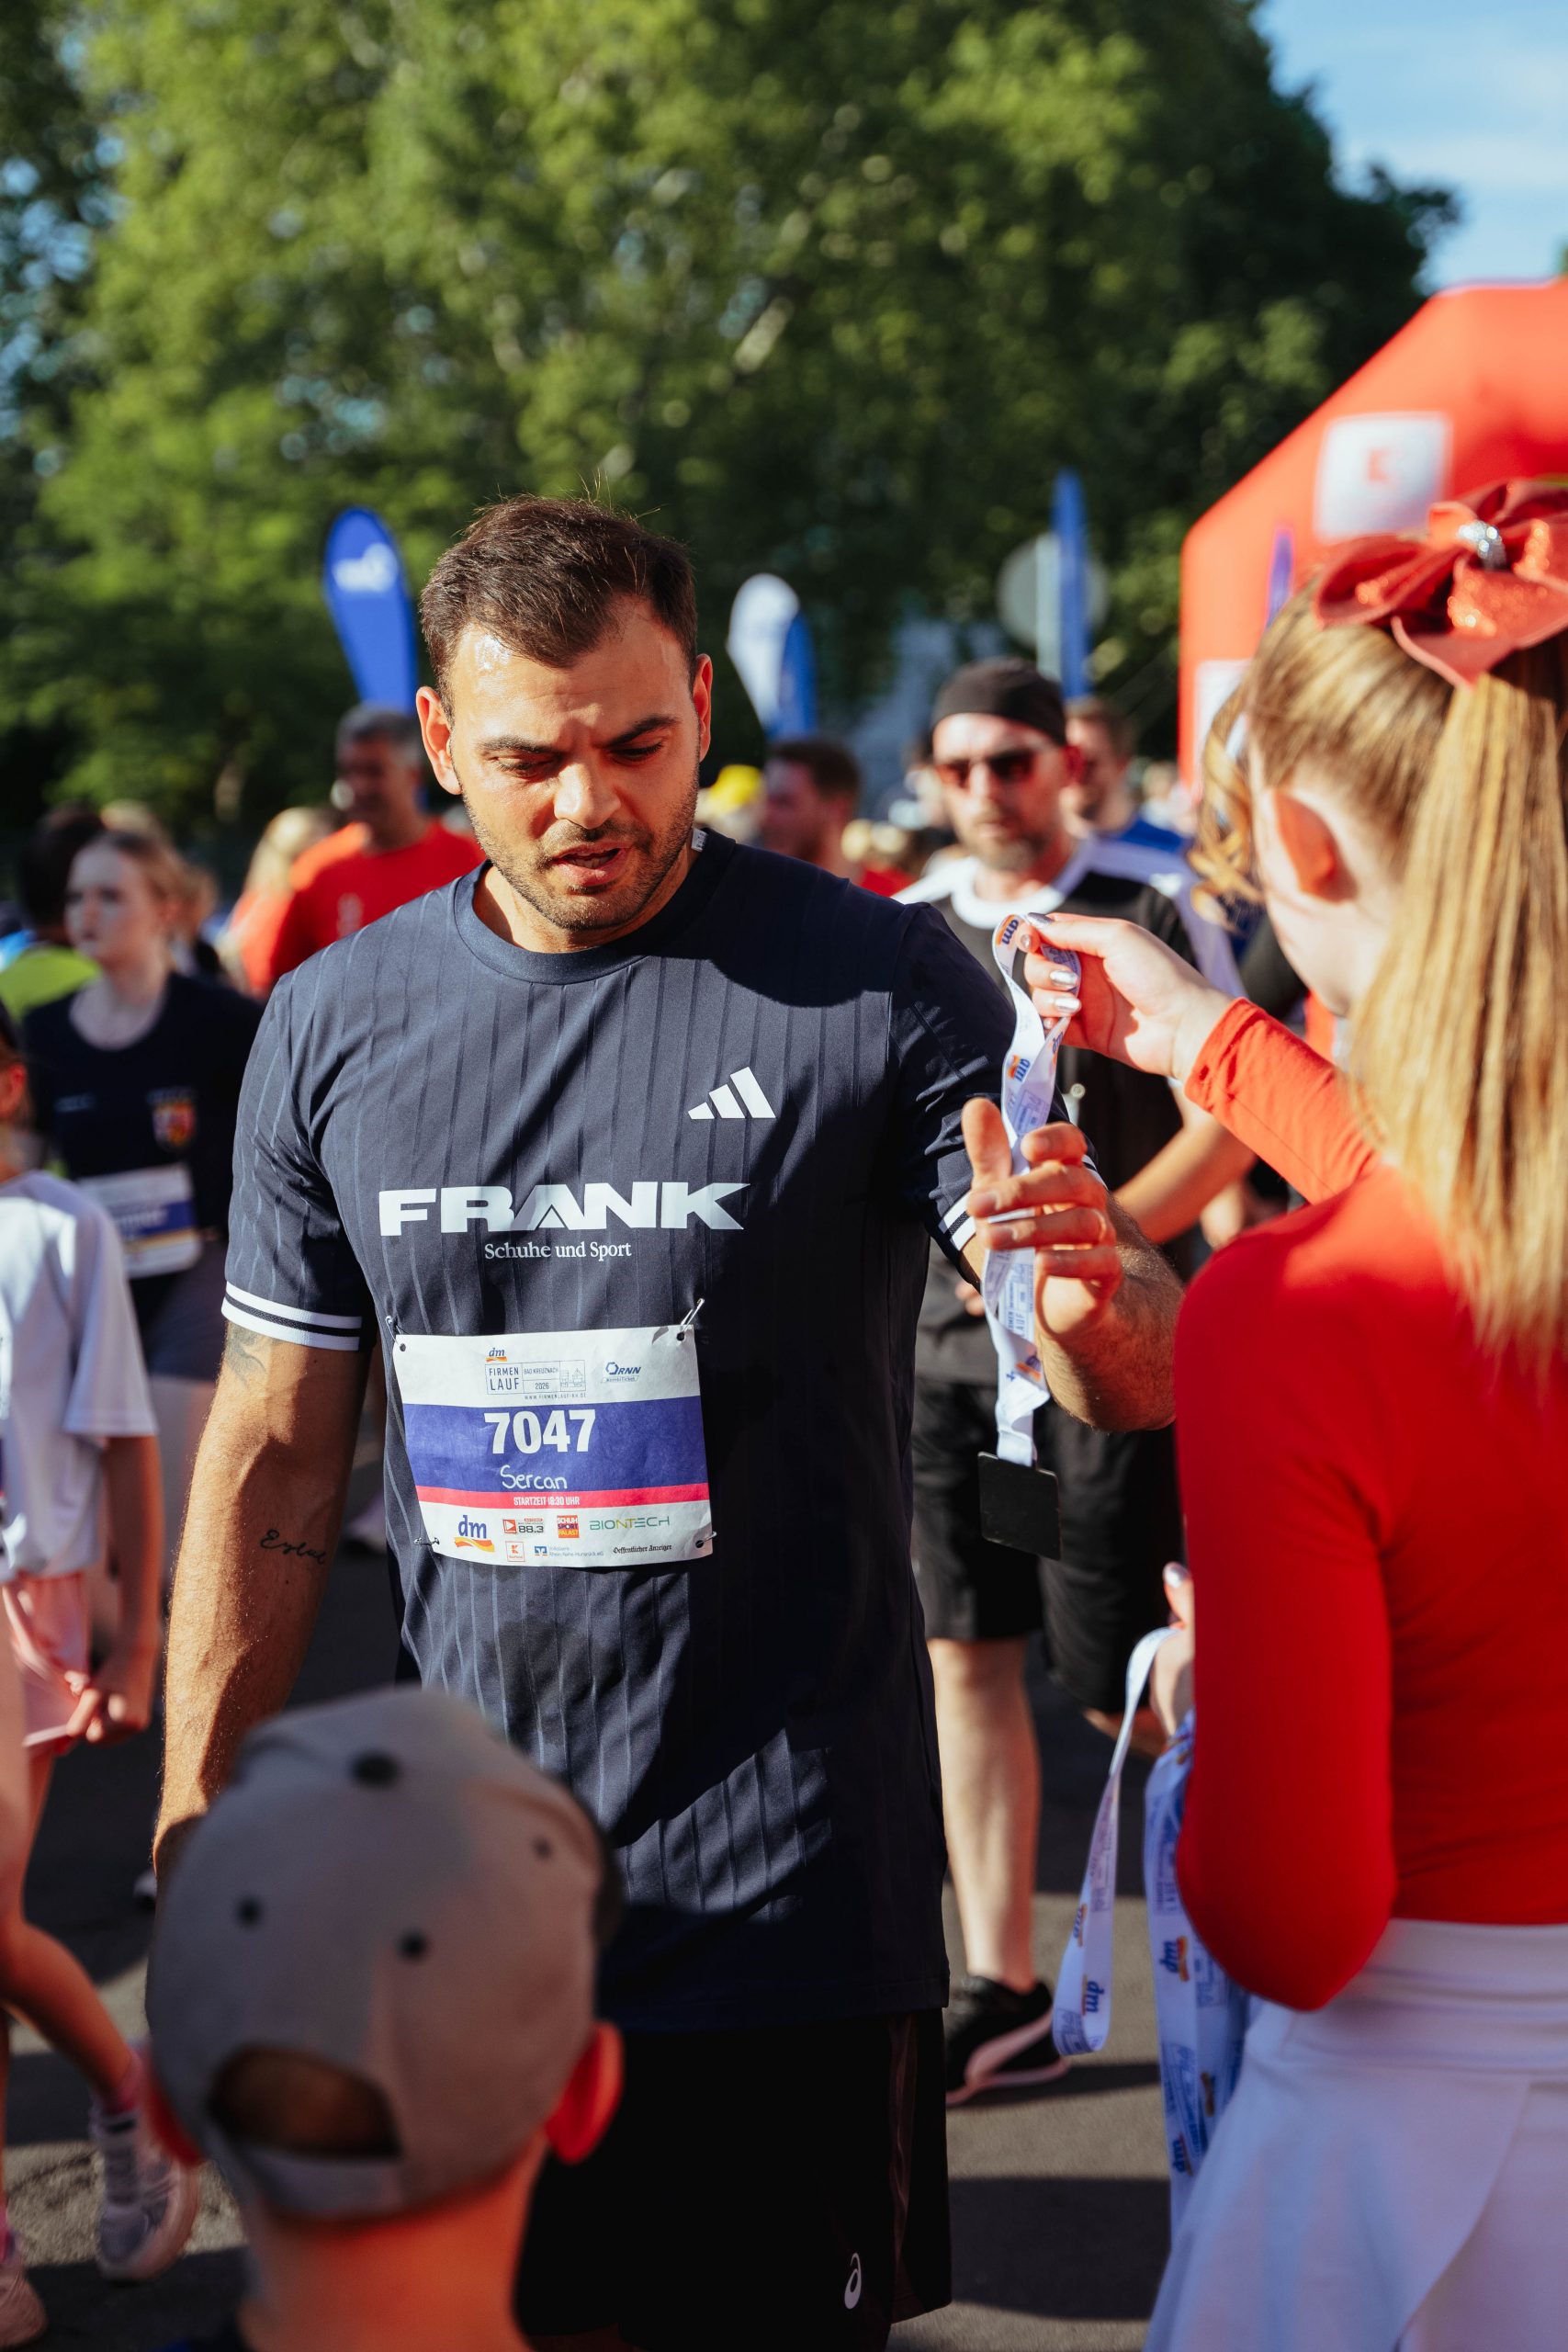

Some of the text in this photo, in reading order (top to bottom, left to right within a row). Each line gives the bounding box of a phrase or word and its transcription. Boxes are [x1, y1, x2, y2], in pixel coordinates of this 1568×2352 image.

[378, 1182, 751, 1237] FRANK
[484, 1240, 632, 1262] Schuhe und Sport
[489, 1347, 505, 1358] dm
[489, 1366, 520, 1376] FIRMEN
[490, 1377, 520, 1391] LAUF
[483, 1408, 596, 1454] 7047
[500, 1464, 569, 1490] Sercan
[513, 1497, 547, 1506] STARTZEIT
[565, 1496, 581, 1506] UHR
[457, 1514, 487, 1540] dm
[518, 1525, 545, 1533] 88.3
[589, 1516, 671, 1531] BIONTECH
[1159, 1939, 1179, 1973] dm
[1086, 1980, 1105, 2013] dm
